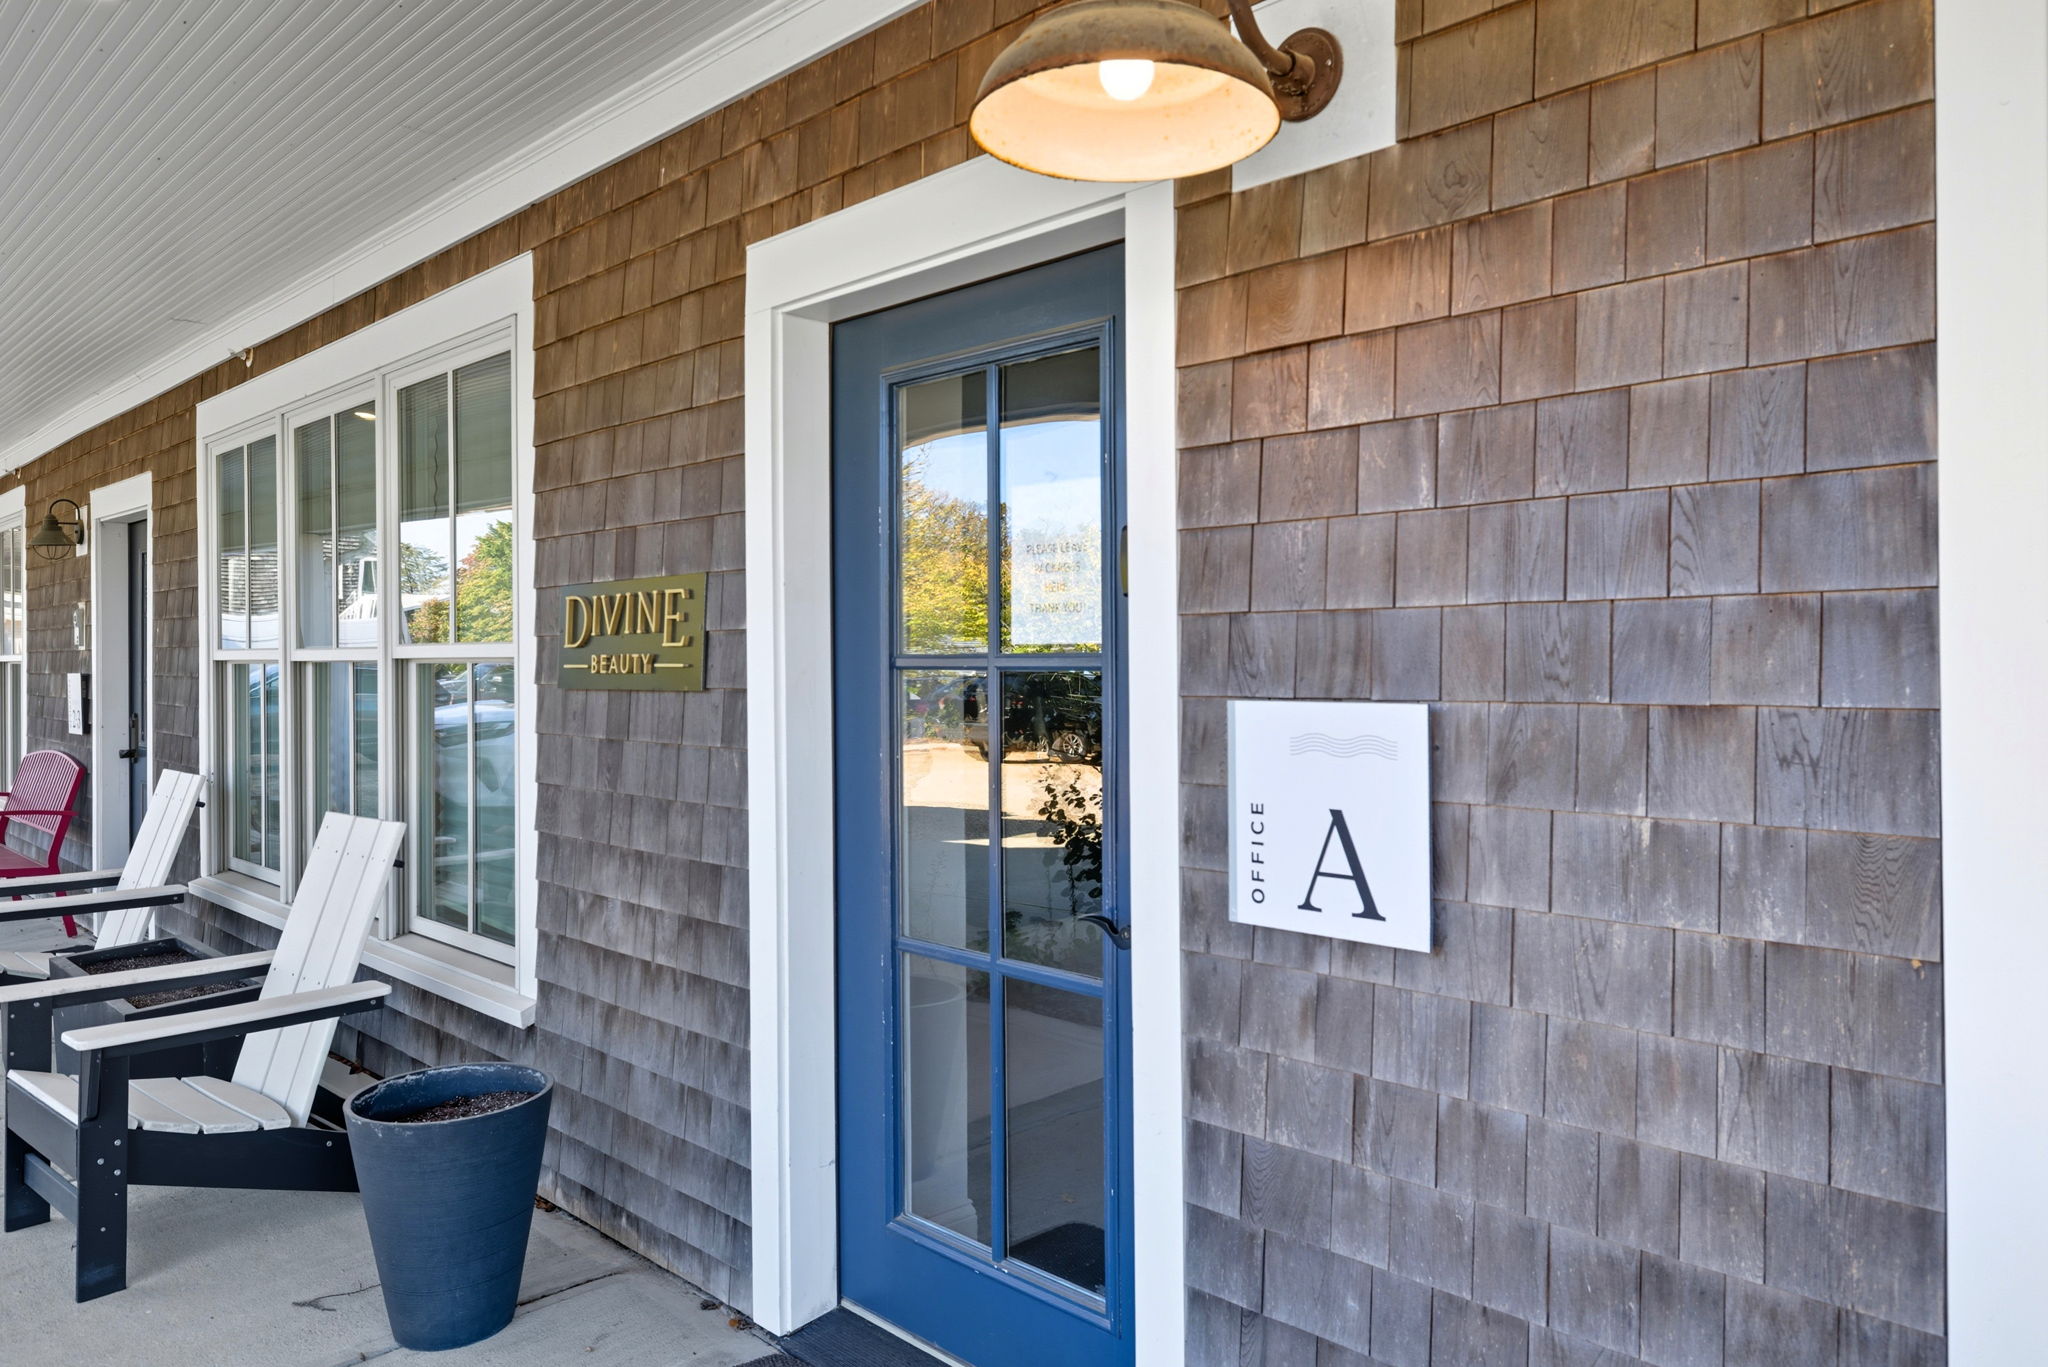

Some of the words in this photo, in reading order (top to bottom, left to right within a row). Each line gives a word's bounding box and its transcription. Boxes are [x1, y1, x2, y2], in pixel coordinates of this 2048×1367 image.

[1026, 543, 1058, 555] PLEASE
[563, 588, 690, 649] DIVINE
[1029, 602, 1060, 614] THANK
[590, 653, 653, 674] BEAUTY
[1250, 802, 1265, 904] OFFICE
[1297, 808, 1387, 922] A
